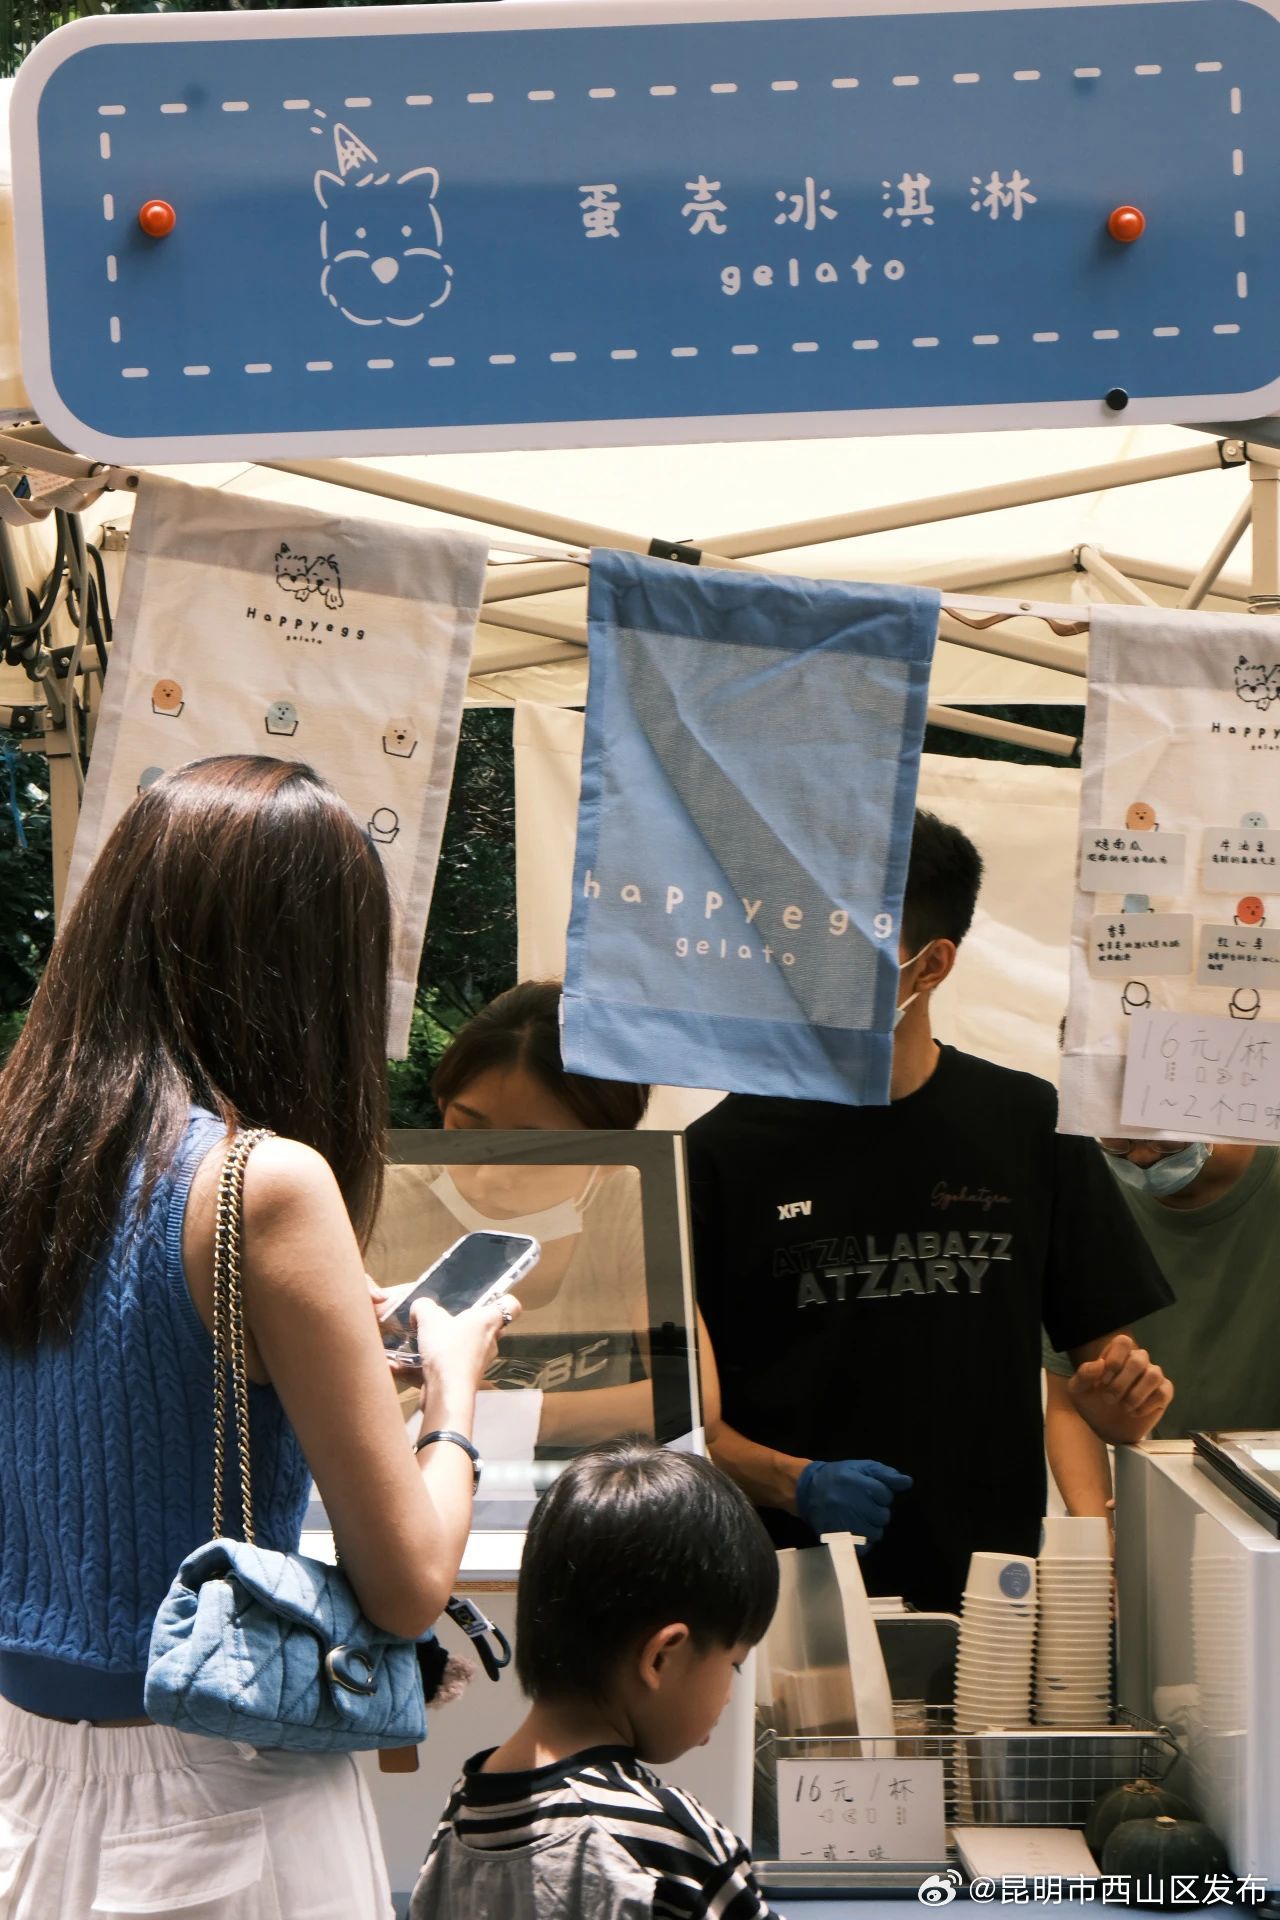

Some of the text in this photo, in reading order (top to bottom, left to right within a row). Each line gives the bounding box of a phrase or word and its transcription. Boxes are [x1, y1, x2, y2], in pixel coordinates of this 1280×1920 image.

[578, 169, 1038, 239] 蛋壳冰淇淋
[720, 254, 906, 296] gelato
[246, 606, 365, 641] Happyegg
[583, 869, 894, 940] happyegg
[675, 937, 797, 967] gelato
[1140, 1018, 1274, 1070] 16元/杯
[776, 1200, 813, 1221] XFV
[797, 1259, 990, 1309] ATZARY
[795, 1772, 915, 1803] 16元/杯
